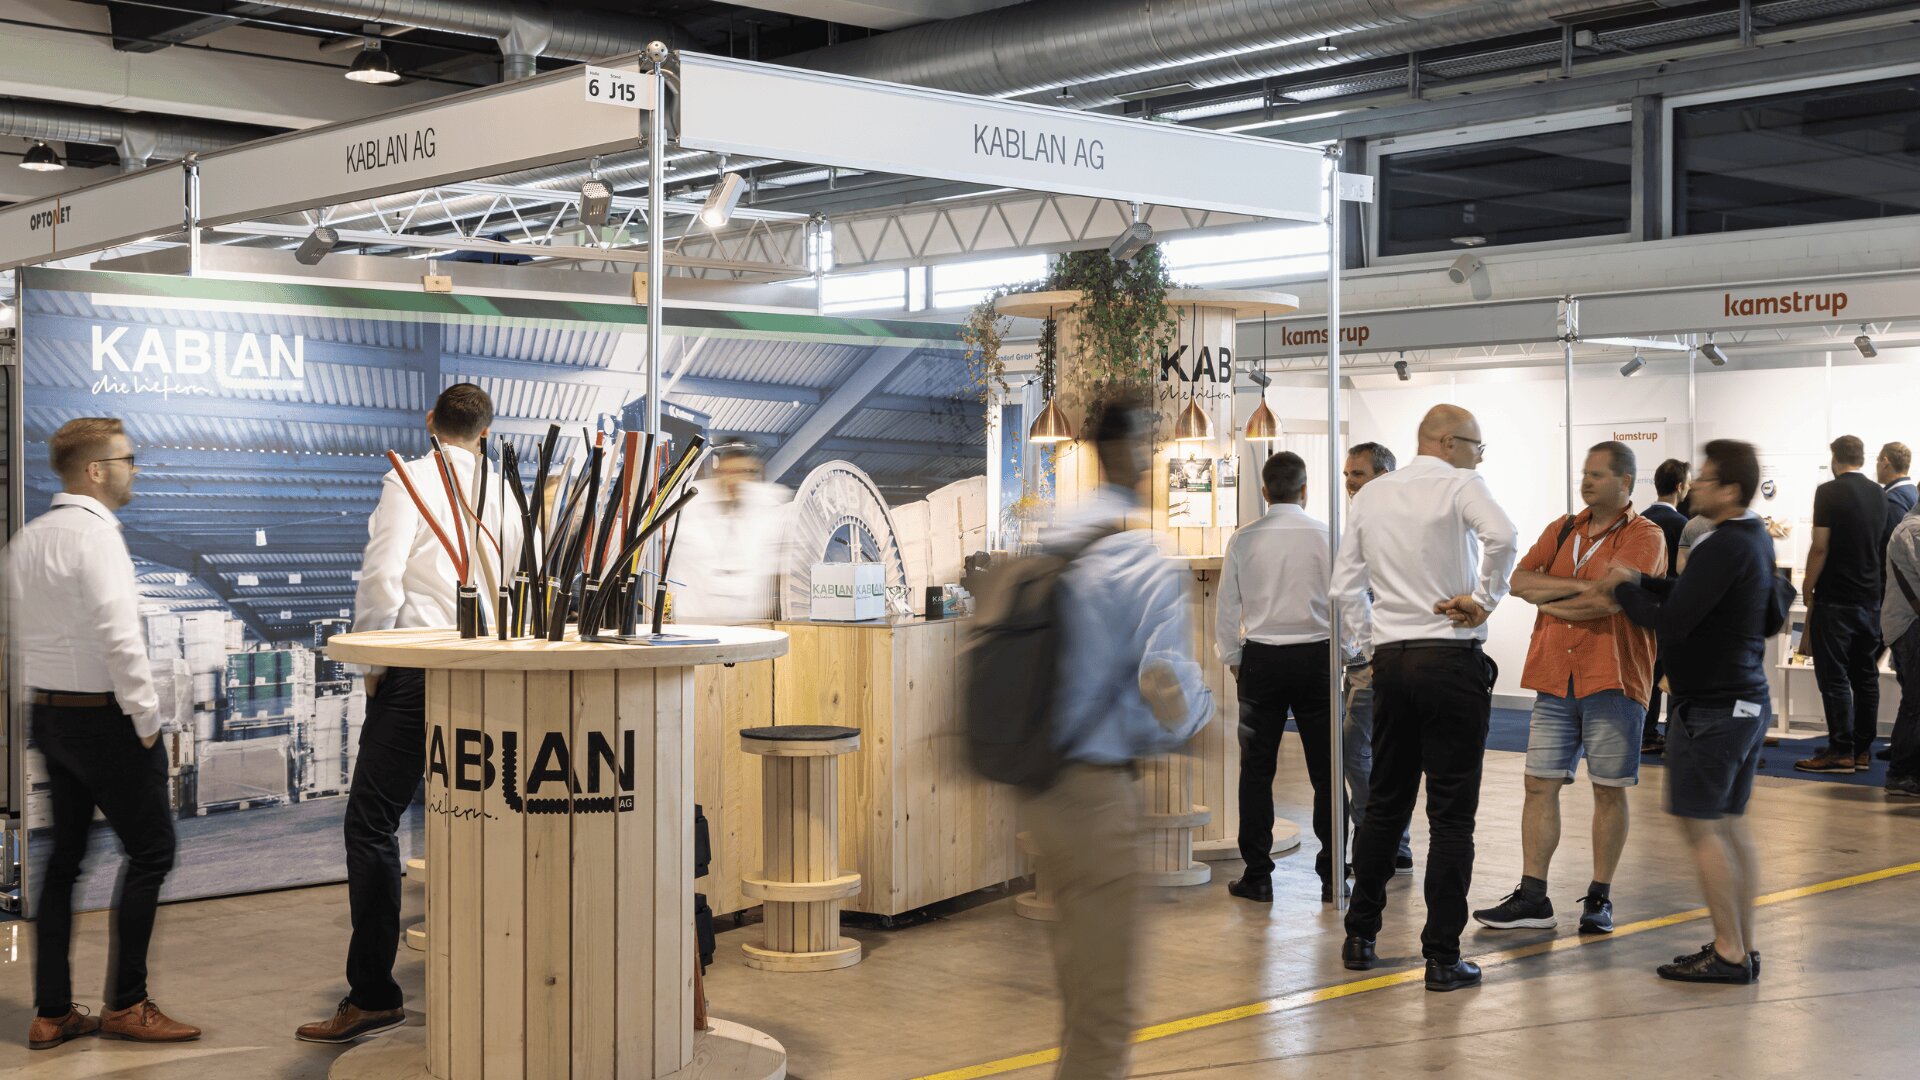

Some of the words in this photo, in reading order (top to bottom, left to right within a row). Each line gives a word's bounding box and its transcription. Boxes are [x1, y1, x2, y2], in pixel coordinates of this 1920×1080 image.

[588, 79, 600, 96] 6
[609, 82, 635, 101] J15
[347, 133, 407, 174] KABLAN
[413, 127, 435, 161] AG
[974, 123, 1066, 165] KABLAN
[1074, 138, 1104, 170] AG
[30, 205, 71, 231] OPTONET
[1724, 291, 1848, 317] kamstrup
[1282, 326, 1370, 347] kamsrup
[92, 325, 304, 391] KABLAN
[1016, 353, 1034, 362] GmbH
[1613, 431, 1658, 442] kamstrup
[812, 583, 854, 598] KABLAN
[855, 583, 885, 597] KABLAN
[619, 798, 632, 808] AG
